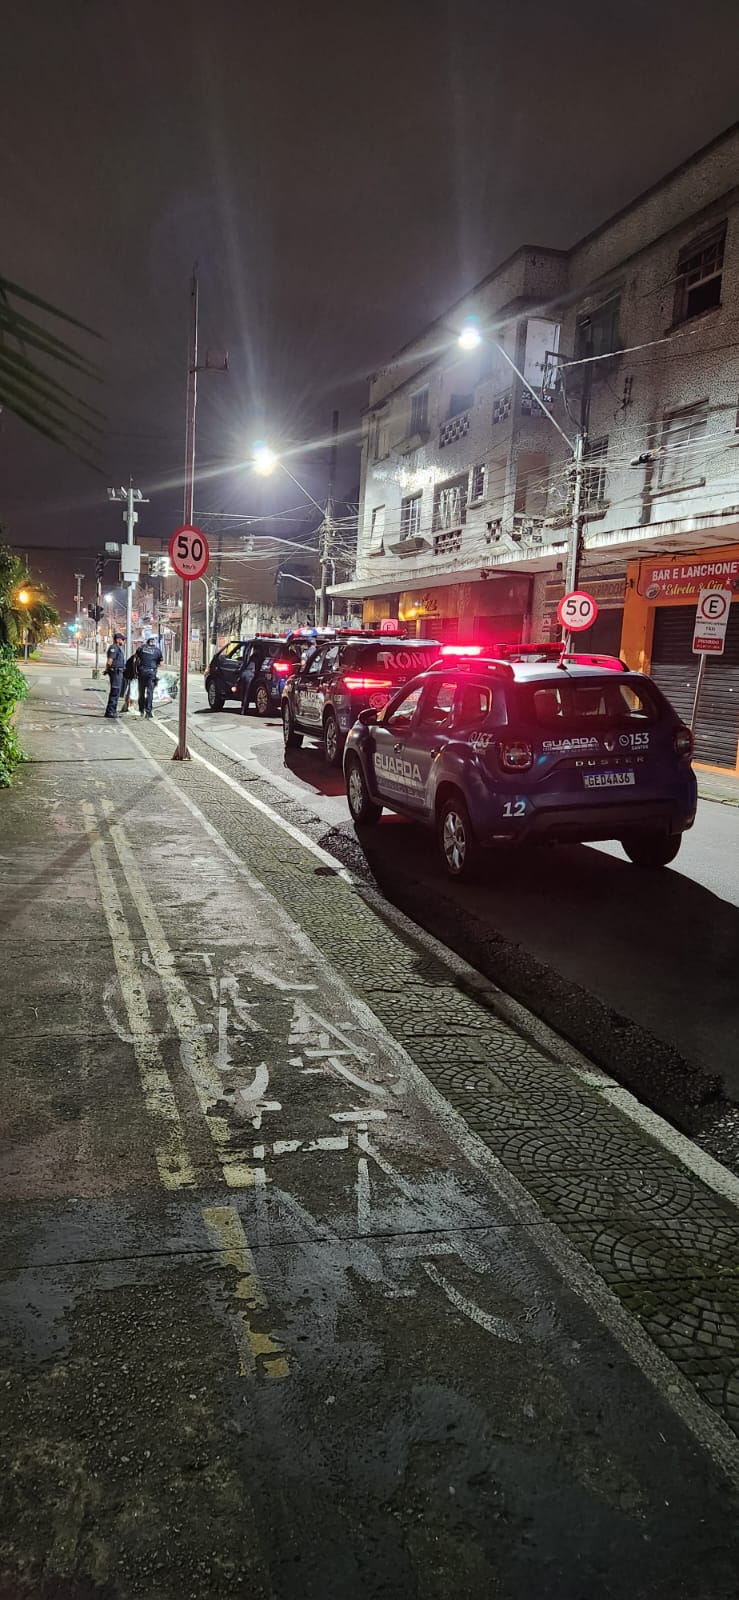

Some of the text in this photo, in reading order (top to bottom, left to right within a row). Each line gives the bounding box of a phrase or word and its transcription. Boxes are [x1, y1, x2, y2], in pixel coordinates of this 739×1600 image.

[177, 535, 203, 561] 50
[652, 561, 739, 581] BAR E LANCHONE
[566, 599, 592, 617] 50
[709, 600, 719, 614] E
[542, 737, 599, 748] GUARDA
[630, 733, 650, 746] 153
[374, 752, 423, 781] GUARDA
[575, 757, 645, 767] DUSTER
[502, 801, 526, 817] 12
